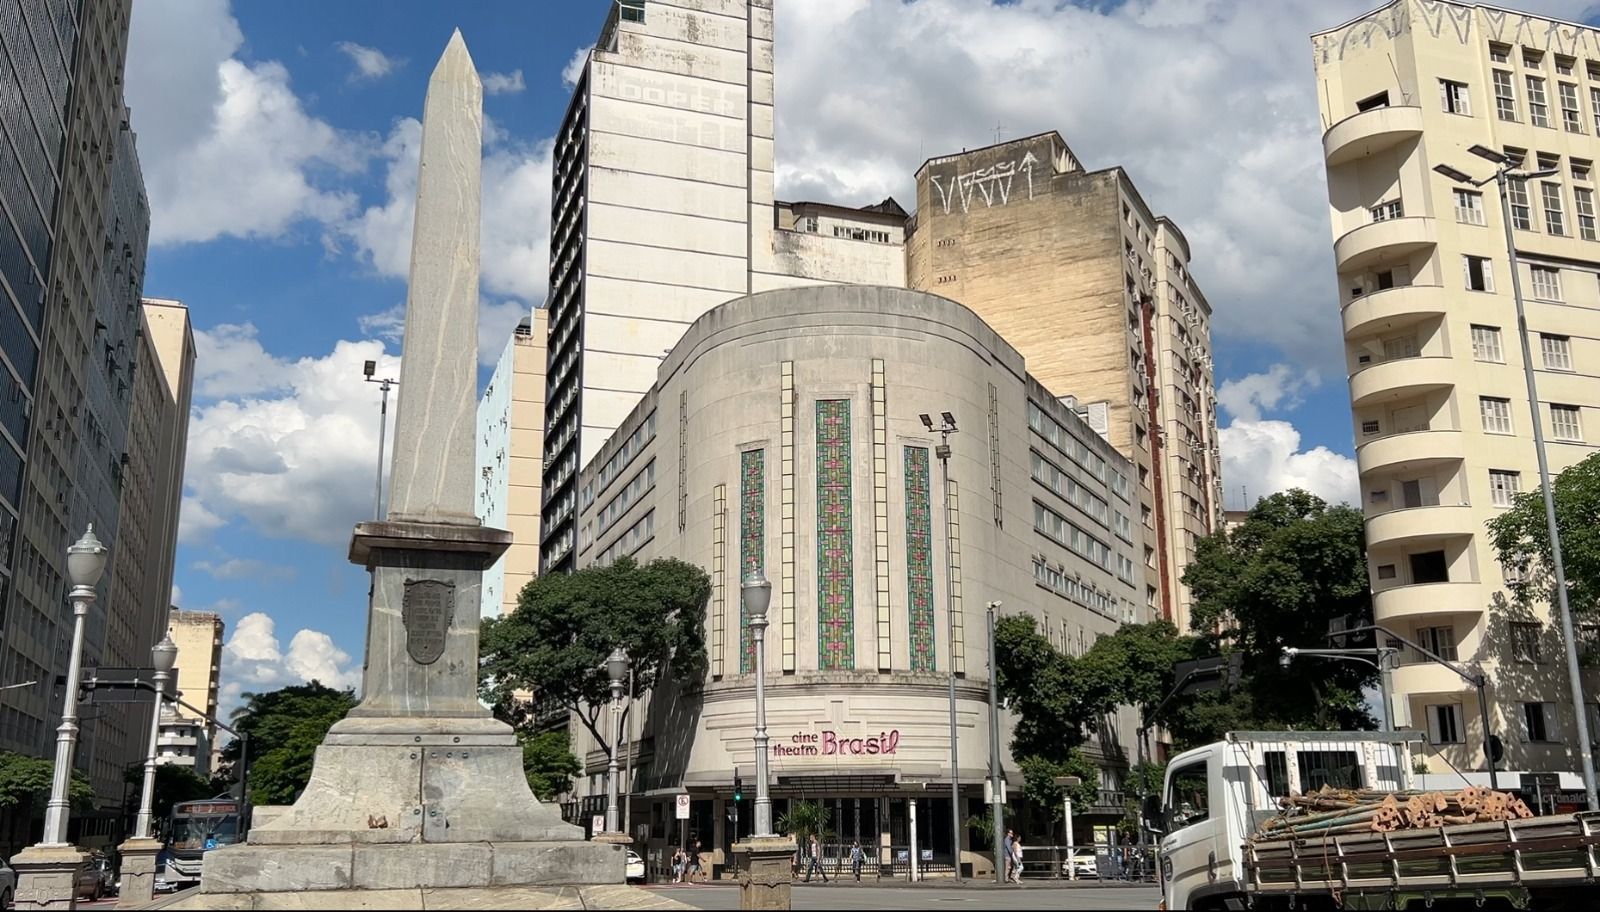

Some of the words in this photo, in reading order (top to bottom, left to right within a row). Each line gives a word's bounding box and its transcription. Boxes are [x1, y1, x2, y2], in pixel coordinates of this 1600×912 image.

[791, 732, 818, 743] cine
[821, 729, 900, 755] Brasil
[773, 744, 818, 756] theatro
